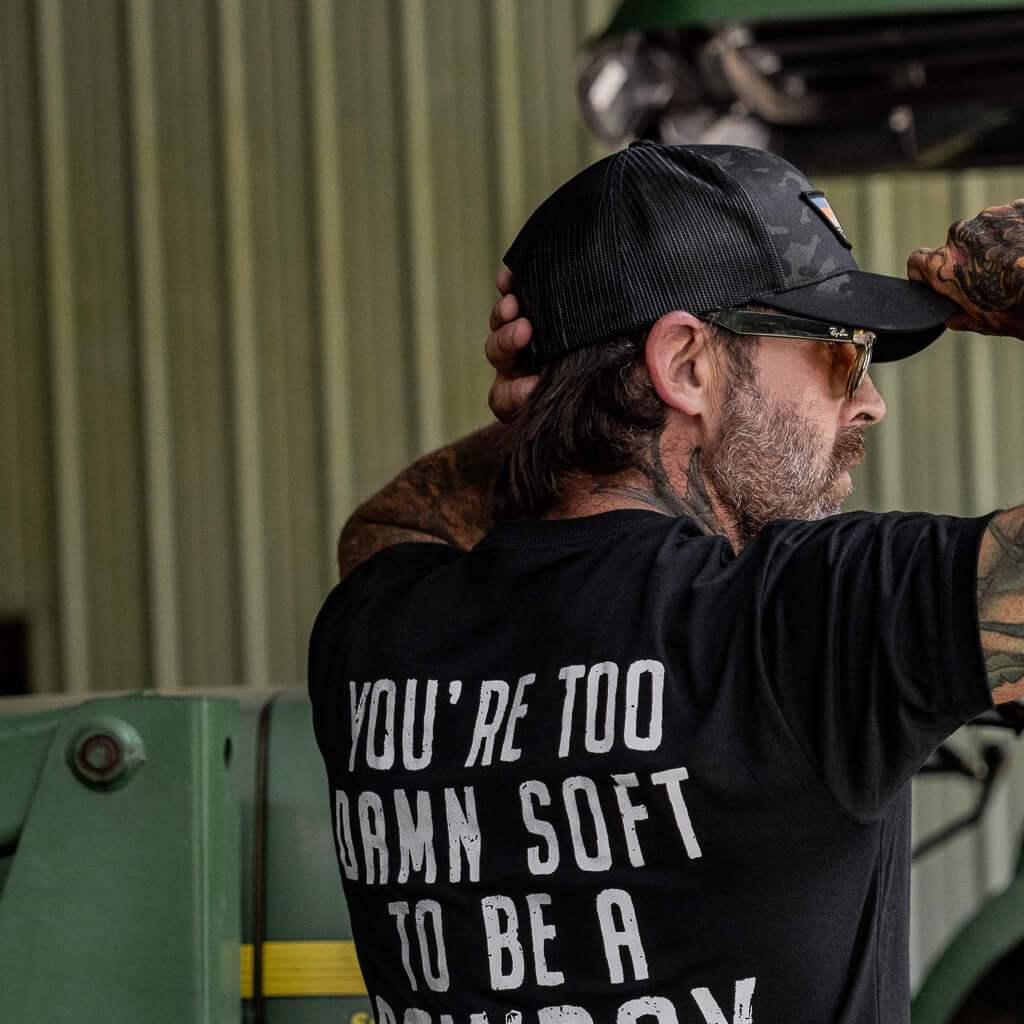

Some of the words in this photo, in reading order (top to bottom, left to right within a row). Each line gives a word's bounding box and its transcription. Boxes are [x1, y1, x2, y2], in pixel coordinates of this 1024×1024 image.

[348, 673, 536, 772] YOU'RE
[558, 659, 665, 758] TOO
[336, 786, 481, 884] DAMN
[519, 767, 702, 875] SOFT
[388, 899, 450, 993] TO
[481, 893, 565, 990] BE
[596, 888, 649, 984] A
